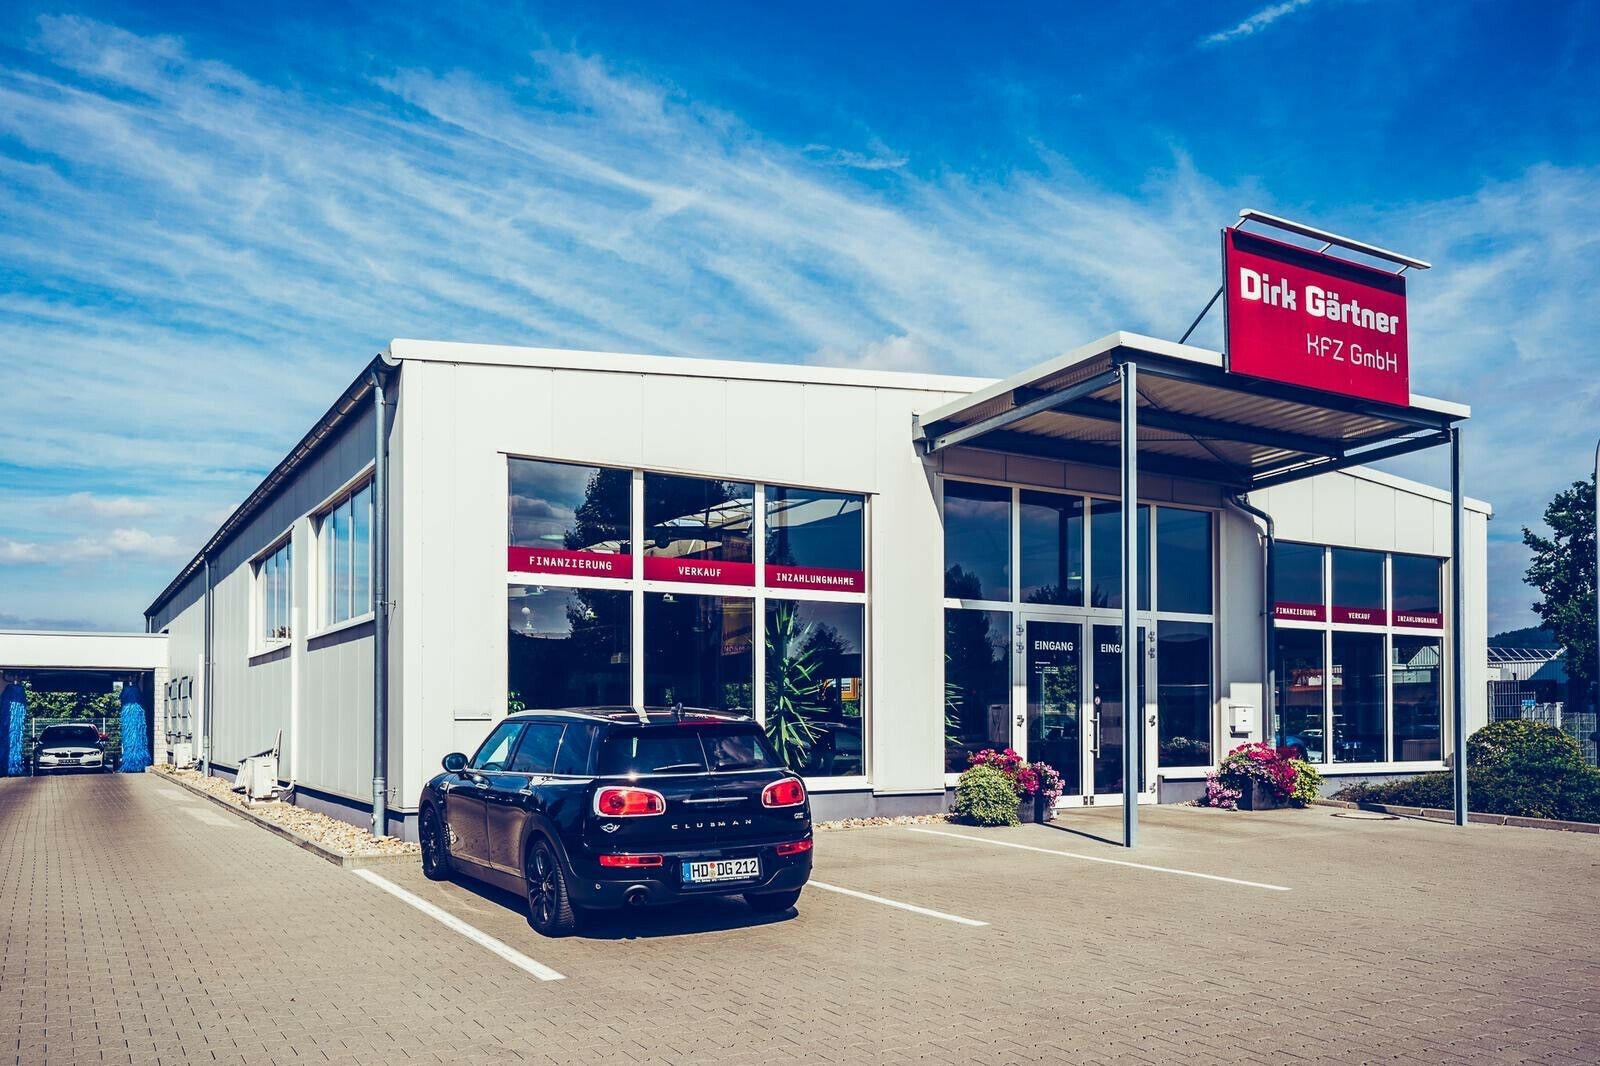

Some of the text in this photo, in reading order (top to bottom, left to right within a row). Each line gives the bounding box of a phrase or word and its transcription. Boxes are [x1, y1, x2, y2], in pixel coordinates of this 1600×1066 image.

[1239, 266, 1399, 335] Dirk Gärtner
[1350, 344, 1398, 373] GmbH
[529, 555, 613, 571] FINANZIERUNG
[677, 566, 722, 577] VERKAUF
[776, 572, 855, 586] INZAHLUNGNAHME
[1275, 606, 1317, 617] FINANZIERUNG
[1348, 612, 1371, 620] VERKAUF
[1034, 640, 1074, 651] EINGANG
[1100, 643, 1123, 653] EING
[671, 819, 752, 830] CLUBMAN
[692, 860, 757, 878] HD DG 212
